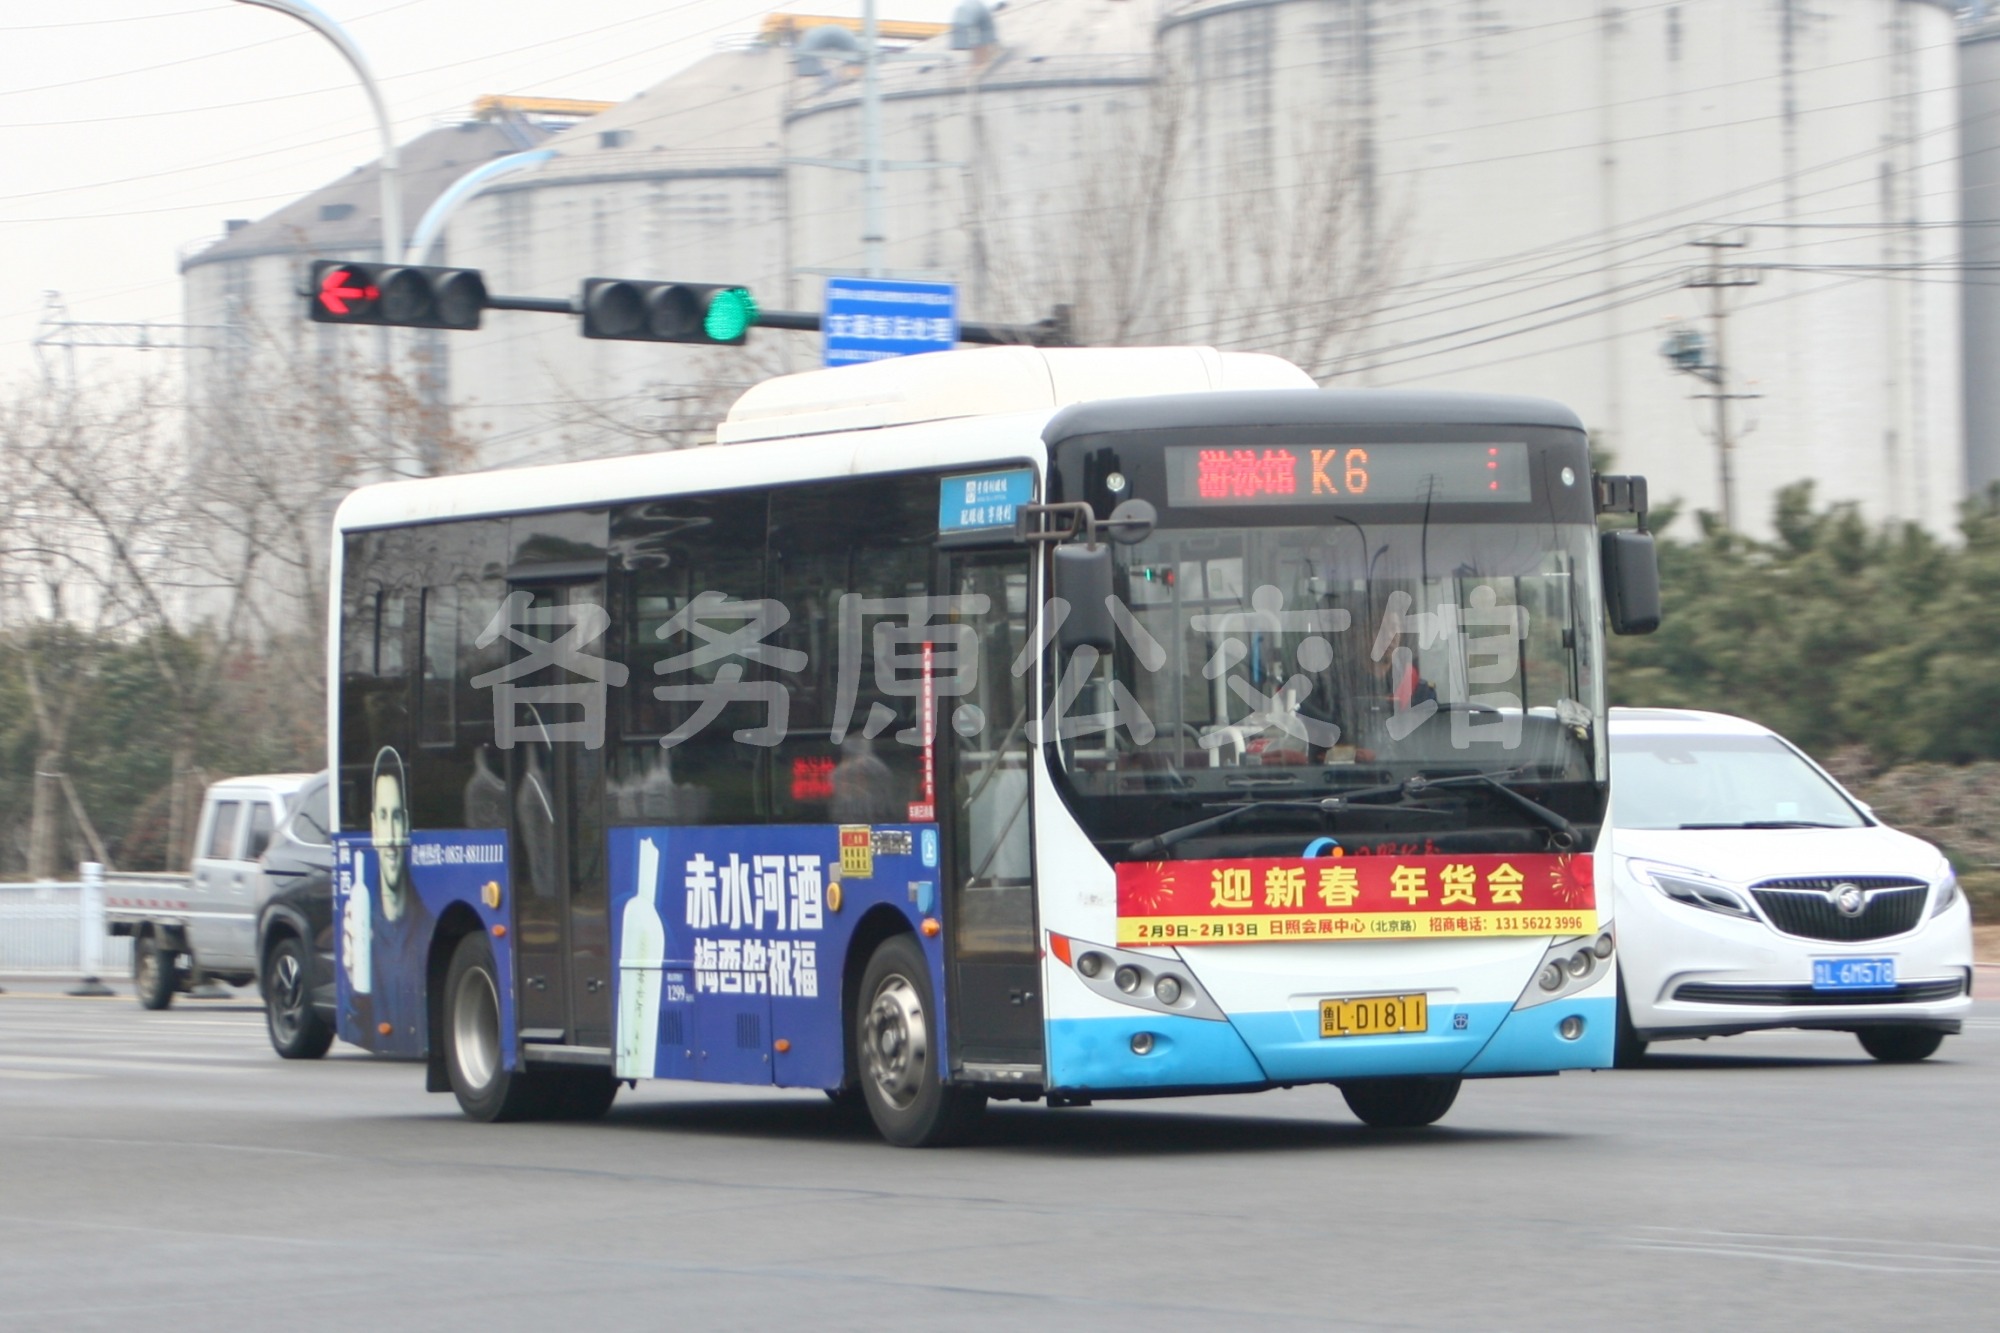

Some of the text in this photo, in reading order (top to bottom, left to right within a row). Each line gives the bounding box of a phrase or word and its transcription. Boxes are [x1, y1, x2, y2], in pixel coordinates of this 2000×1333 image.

[1310, 448, 1368, 494] K6
[685, 853, 823, 930] 赤水河酒
[1210, 862, 1525, 909] 迎新春 年货会
[694, 937, 818, 997] 梅西的祝福
